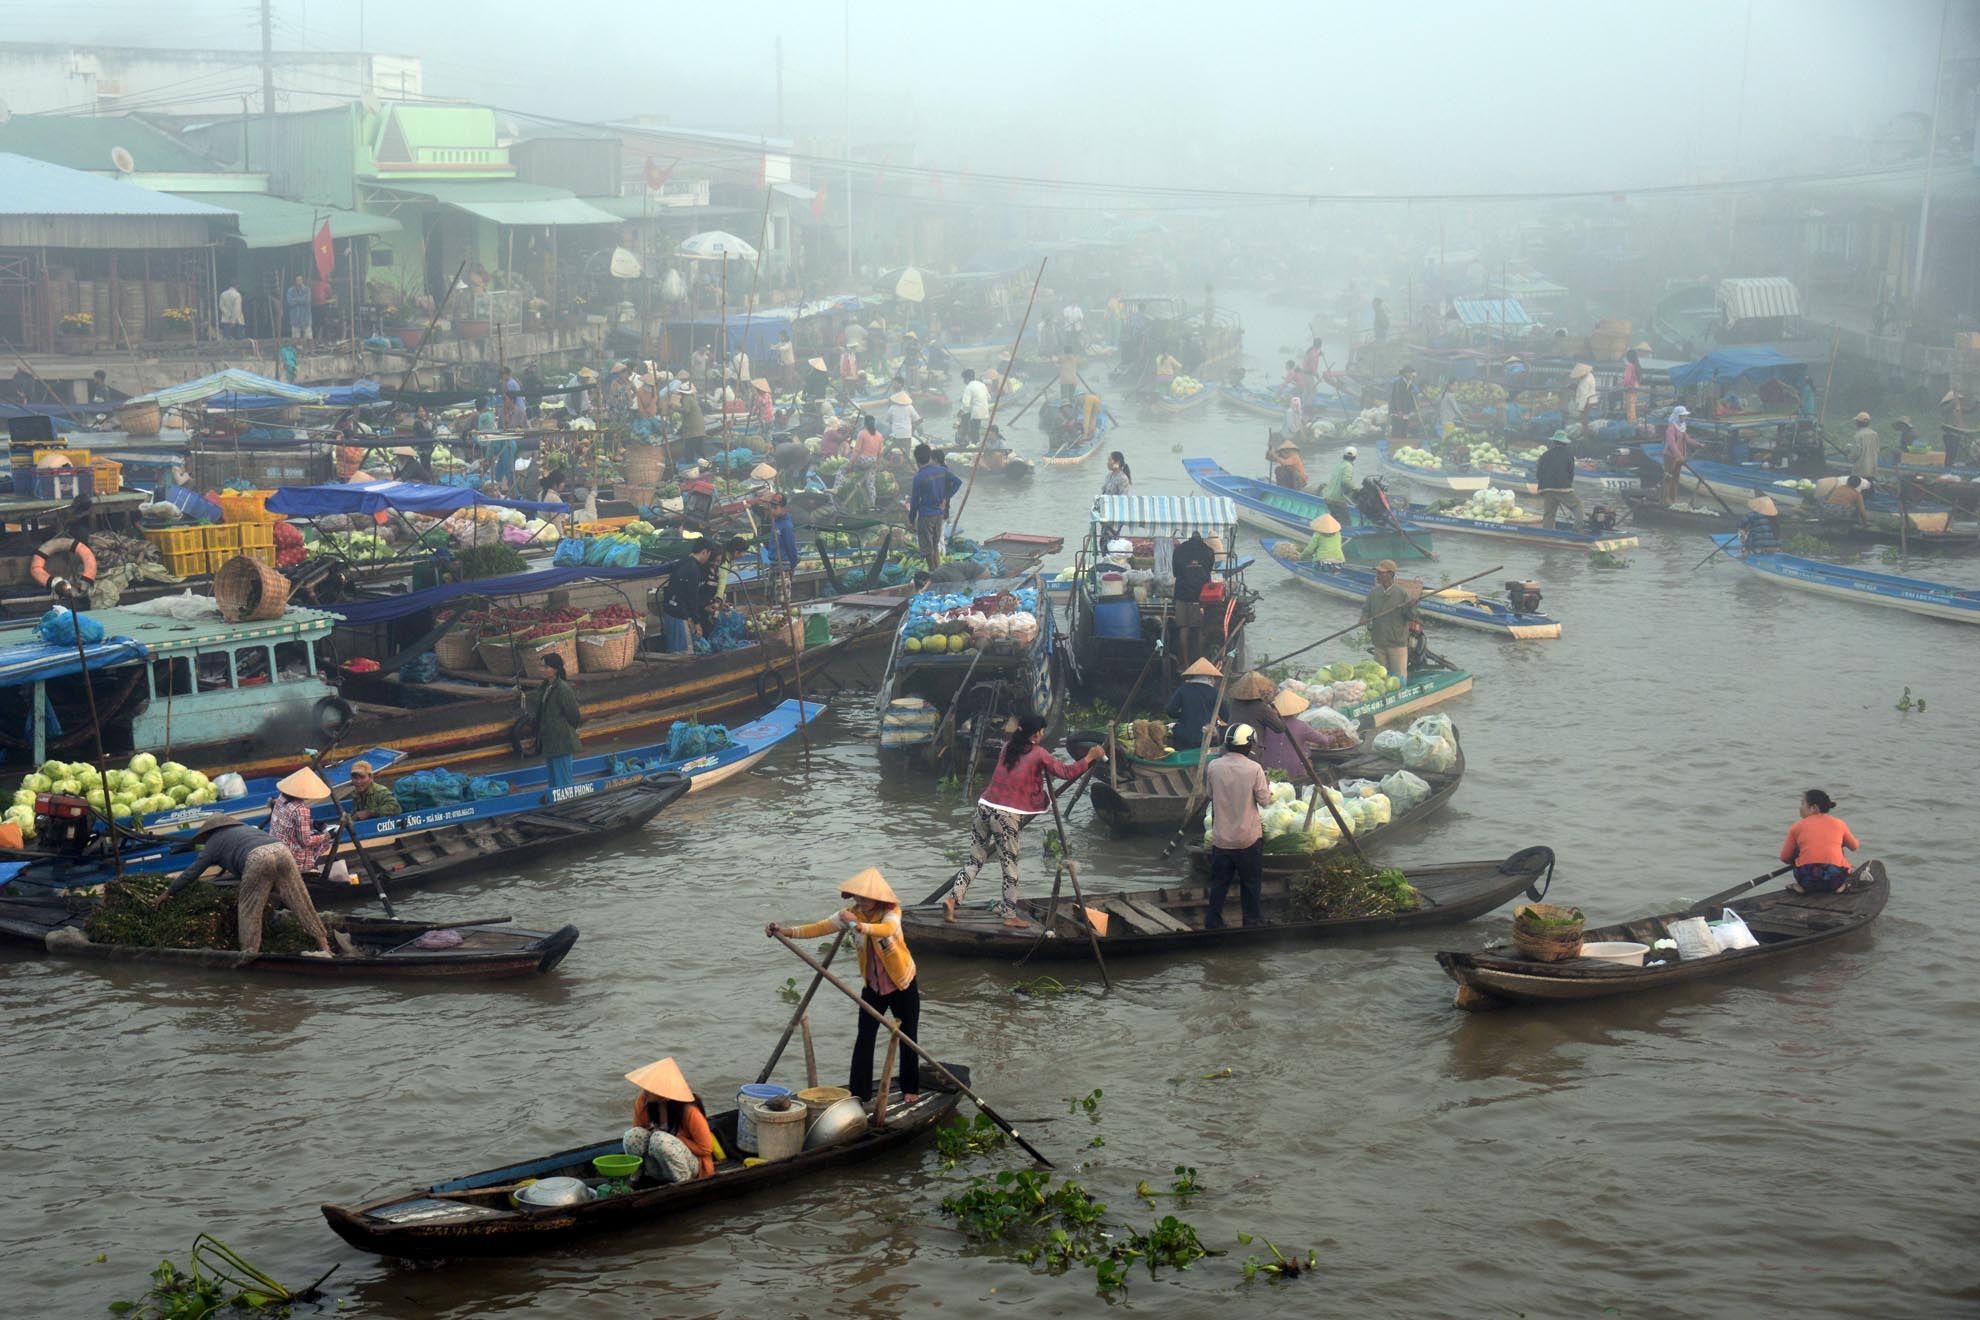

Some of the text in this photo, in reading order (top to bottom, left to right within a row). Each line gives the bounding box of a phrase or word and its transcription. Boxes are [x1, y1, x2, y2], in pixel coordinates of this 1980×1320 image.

[552, 783, 594, 802] THANH PHONG
[377, 818, 395, 832] CHÍN
